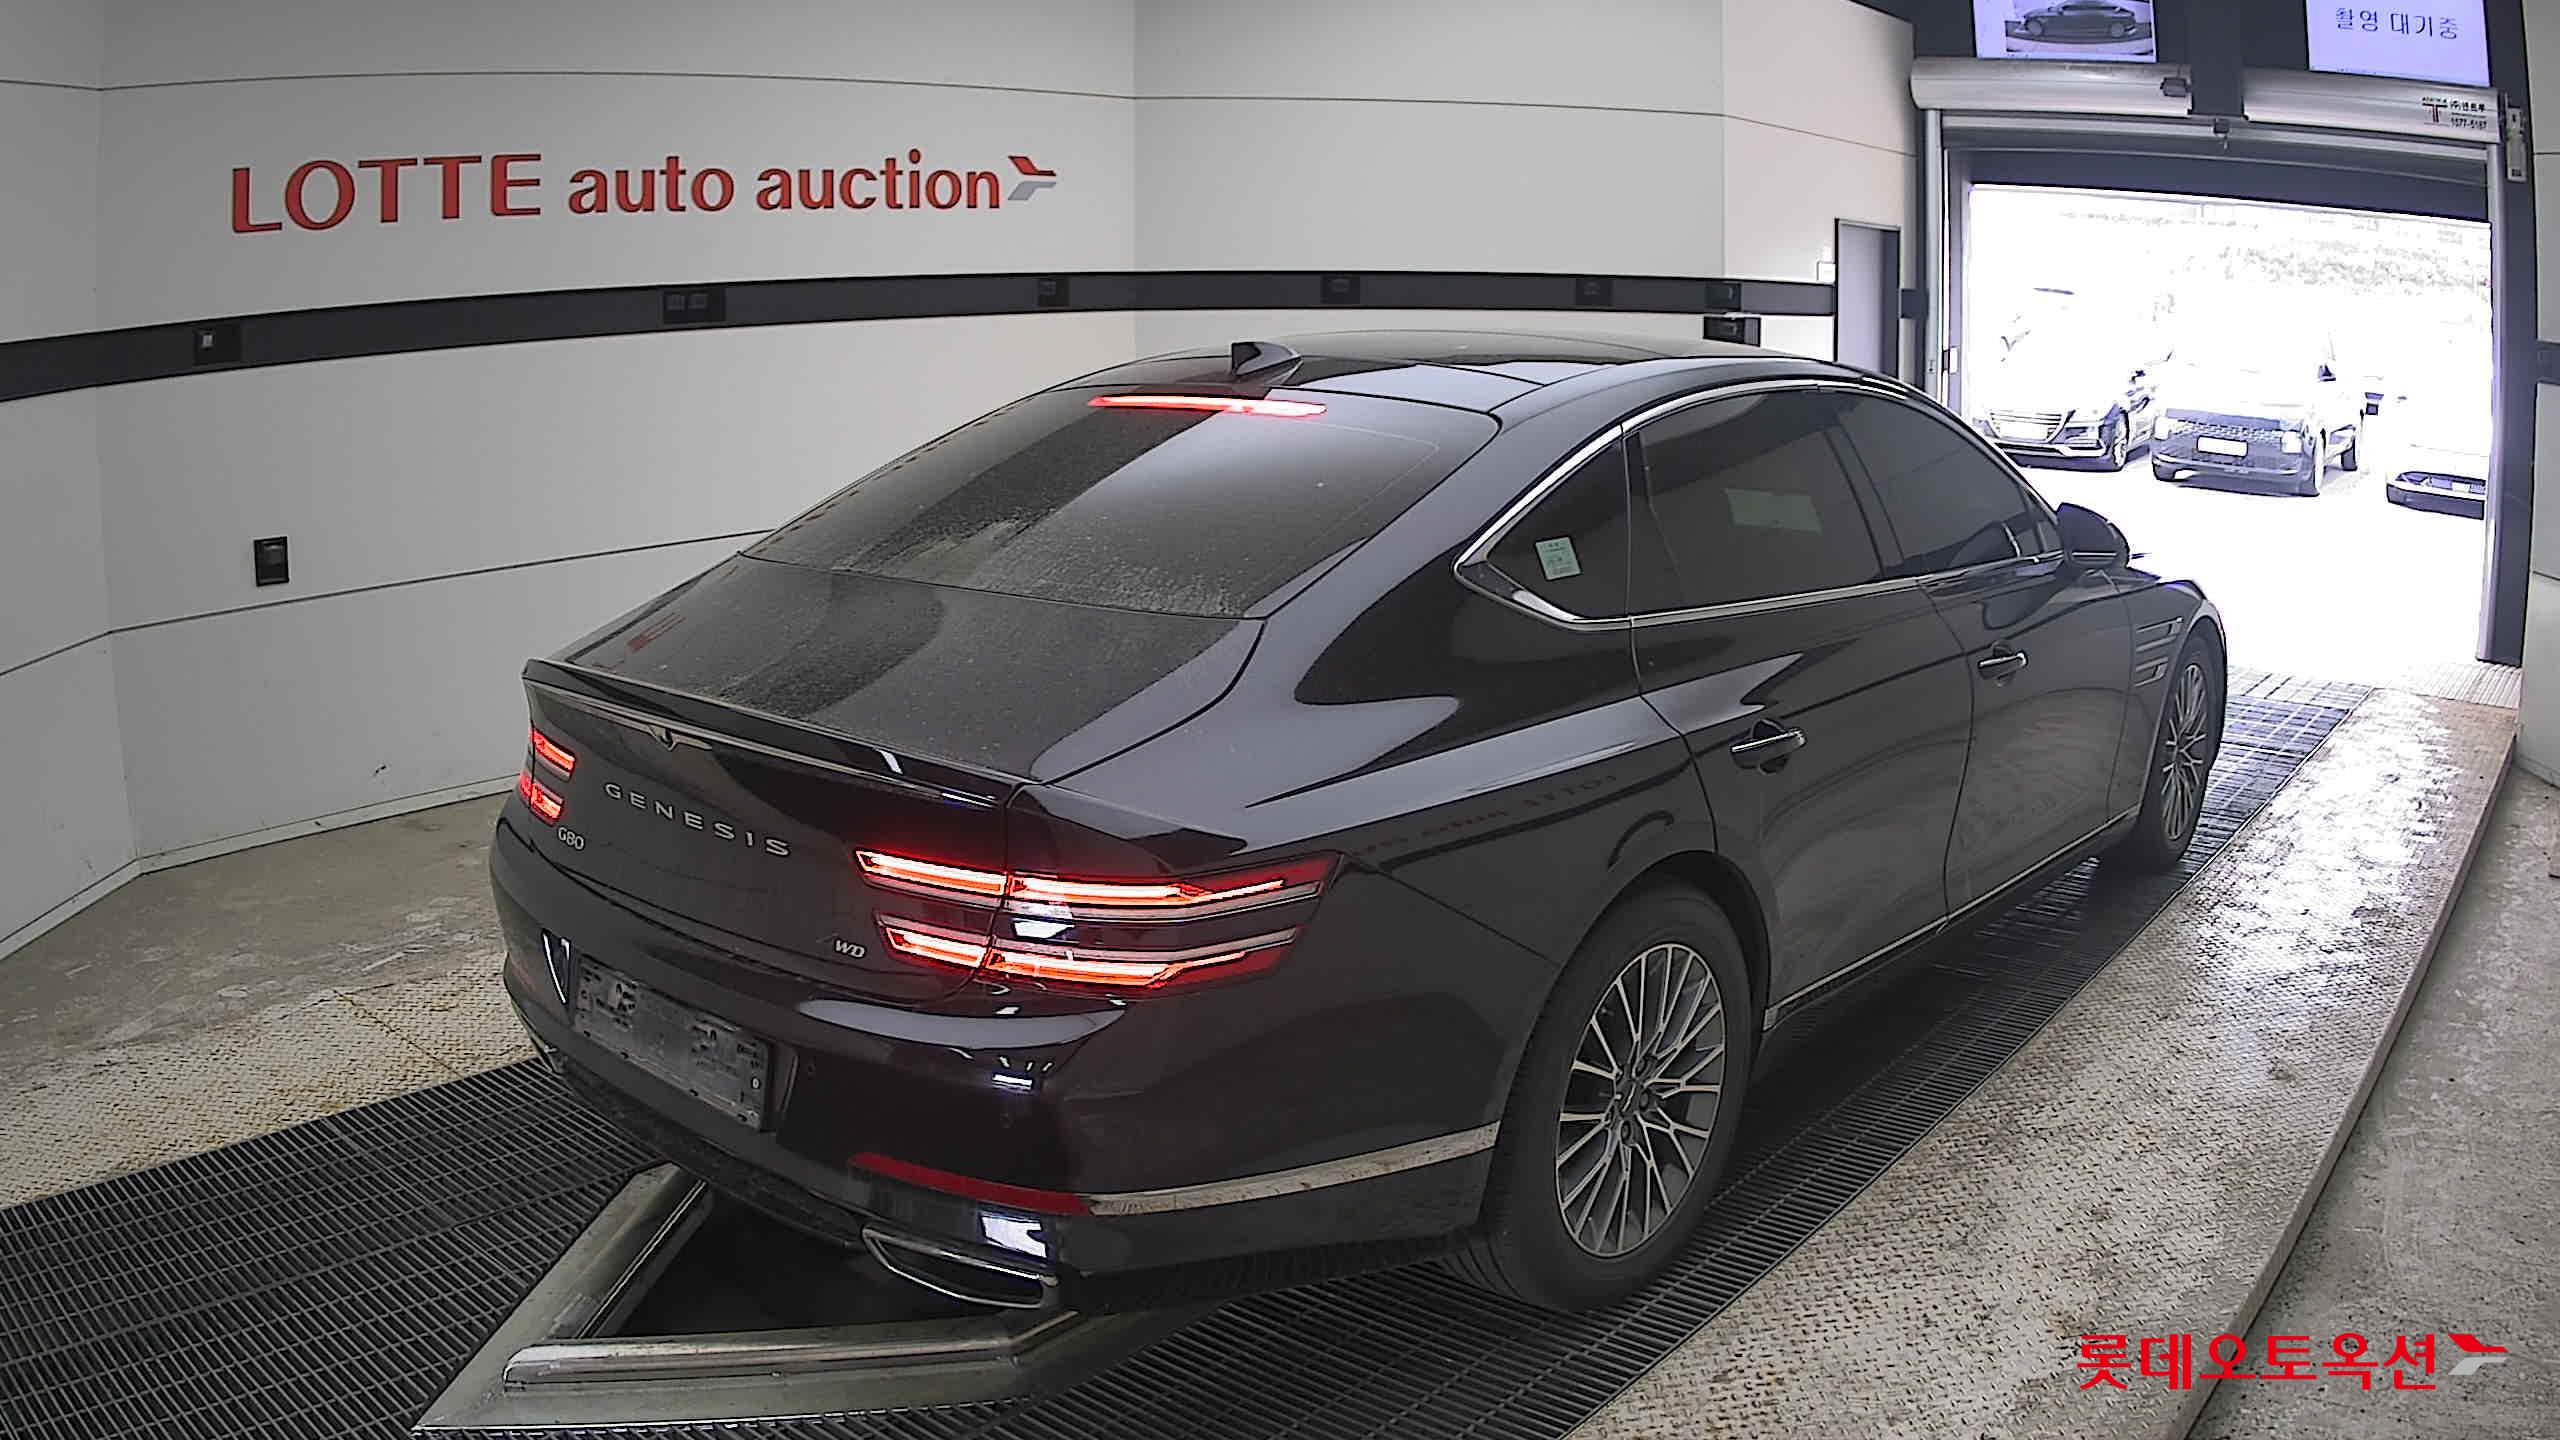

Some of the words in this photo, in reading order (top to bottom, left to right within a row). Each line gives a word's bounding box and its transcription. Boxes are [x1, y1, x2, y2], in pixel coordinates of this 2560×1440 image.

[232, 154, 541, 233] LOTTE
[569, 156, 734, 213] auto
[756, 150, 1001, 211] auction
[557, 826, 585, 850] G80
[604, 783, 790, 857] GENESIS
